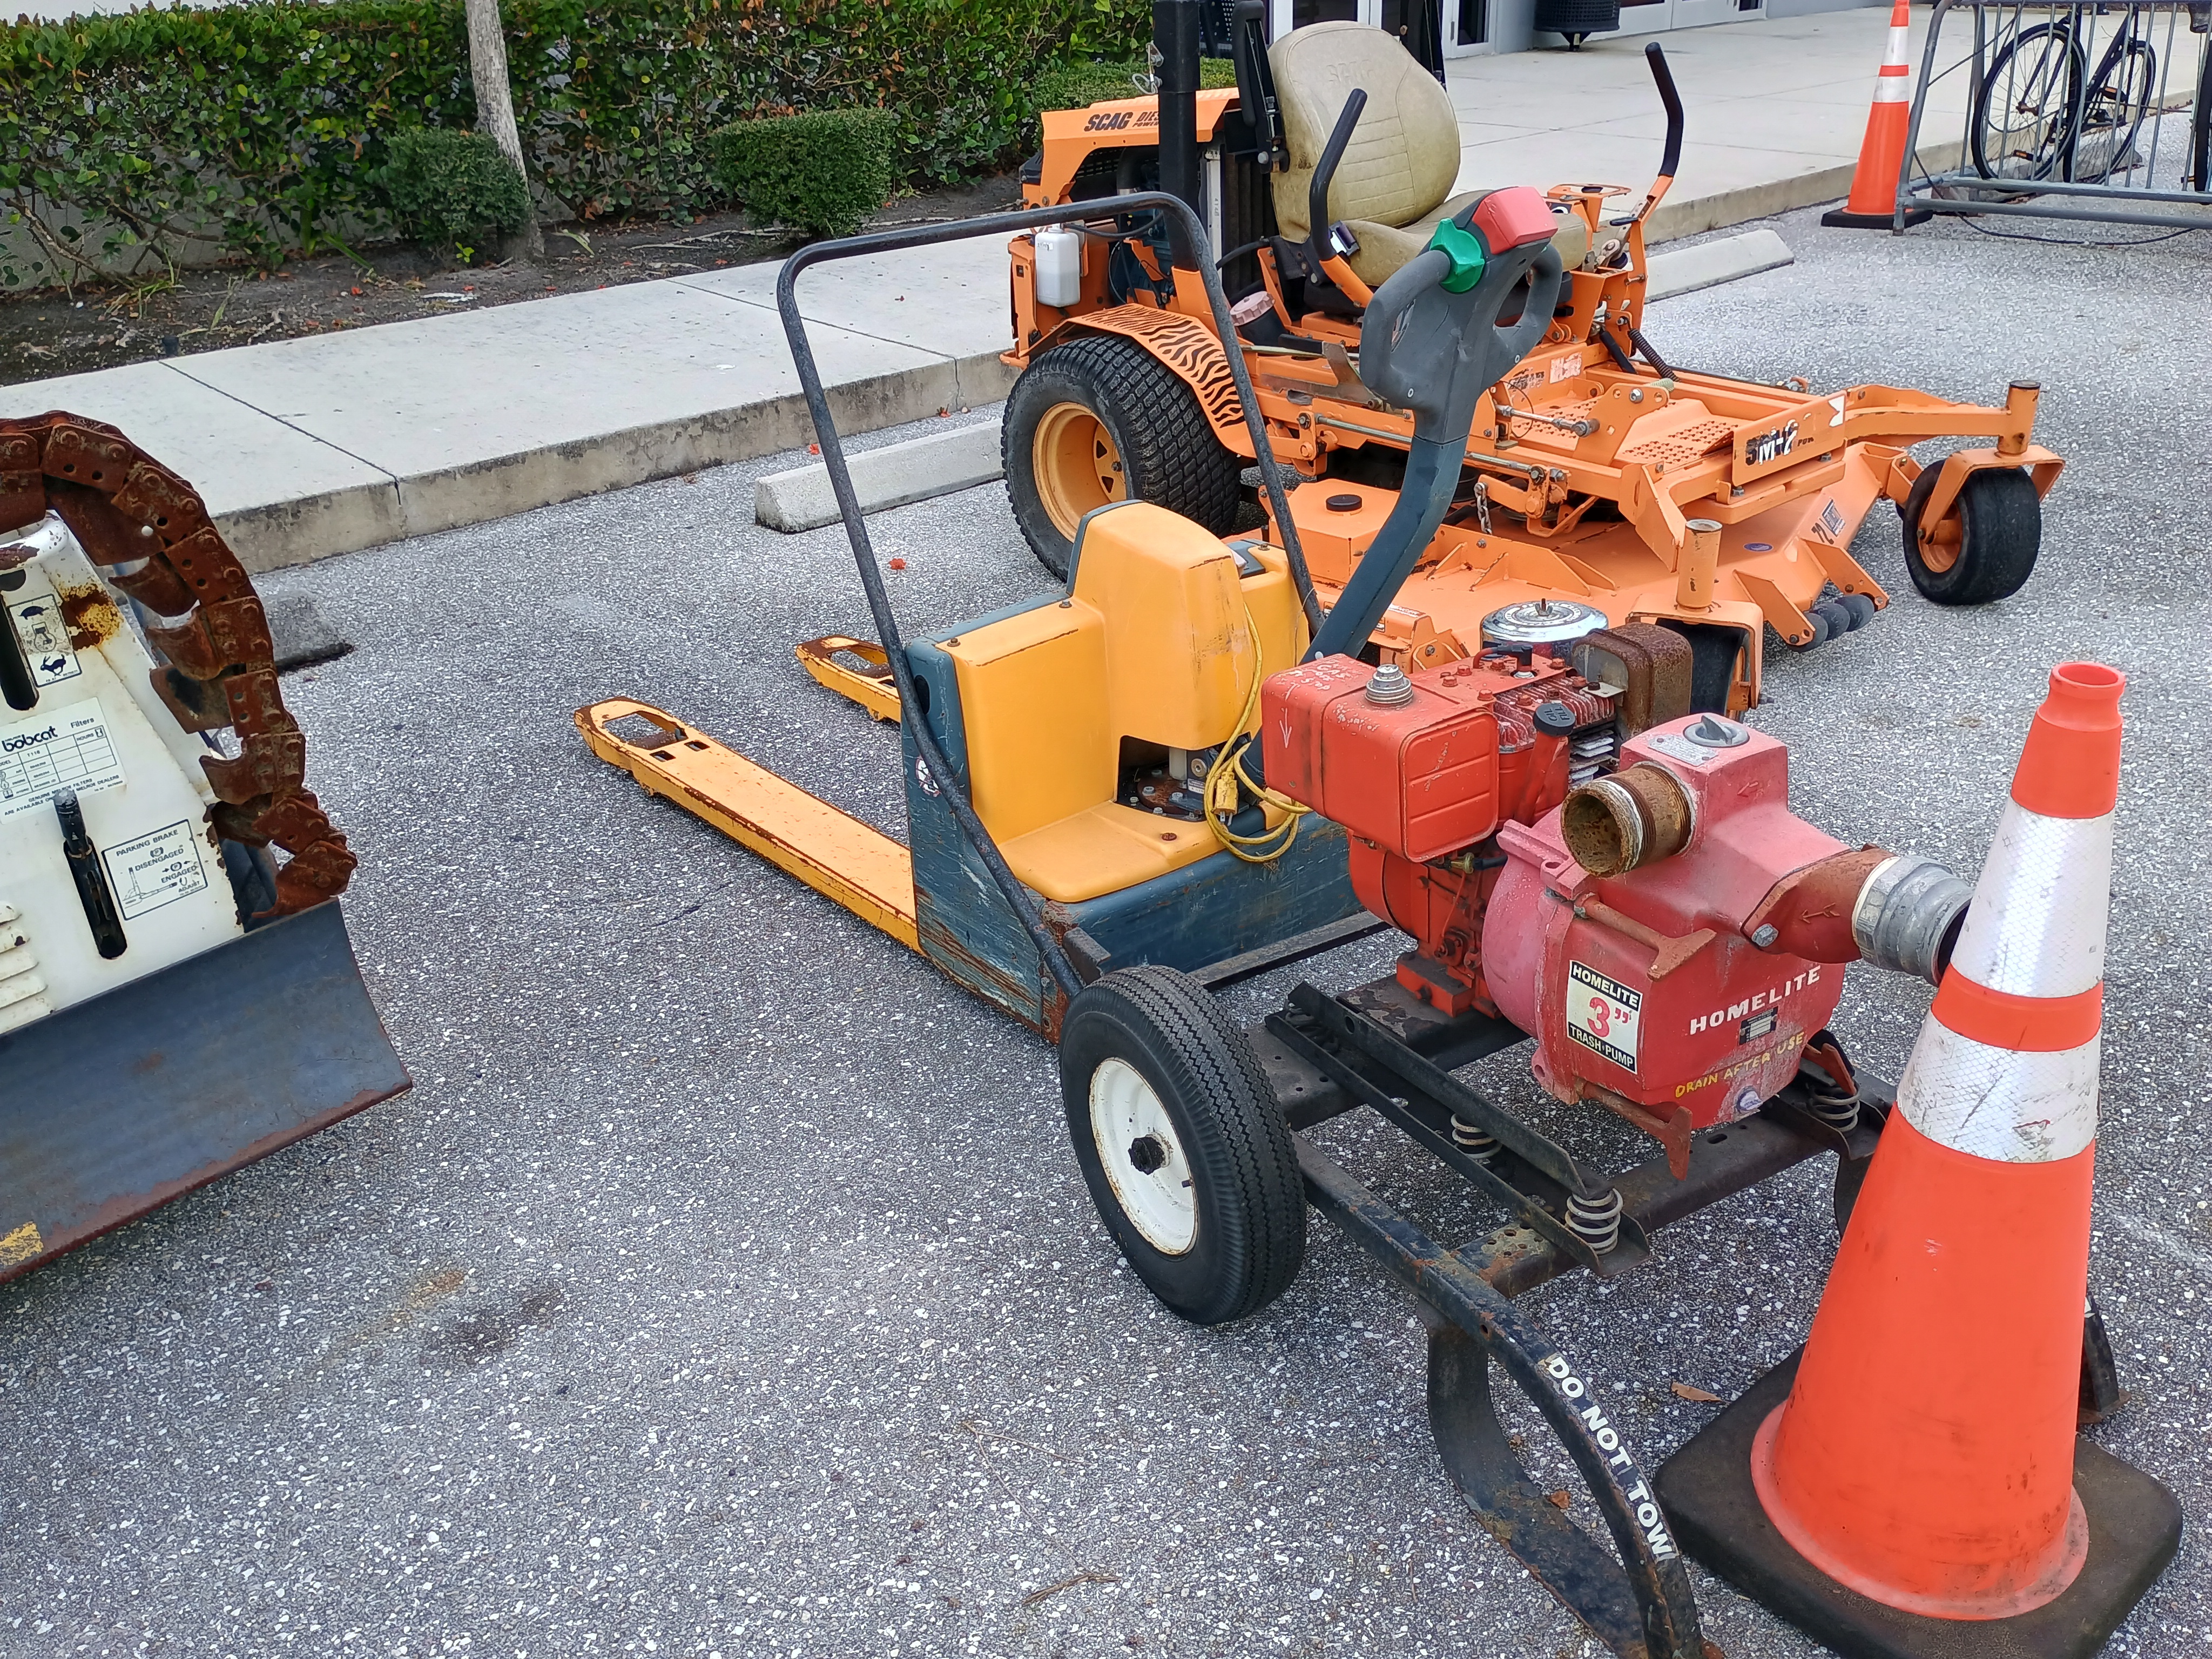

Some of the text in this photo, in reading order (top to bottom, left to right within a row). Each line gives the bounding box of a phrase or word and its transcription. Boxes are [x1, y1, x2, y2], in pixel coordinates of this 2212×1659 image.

[1084, 111, 1159, 132] SCAG DIE
[70, 718, 95, 729] Filters
[1544, 709, 1558, 721] OIL
[1555, 707, 1570, 720] FILL
[2, 726, 58, 752] bobcat
[77, 733, 94, 741] HOURS
[16, 800, 44, 812] AVAILABLE
[76, 783, 96, 792] MELROE
[97, 774, 119, 785] DEALERS
[29, 792, 50, 802] GENUINE
[73, 778, 93, 787] FILTERS
[116, 830, 179, 857] PARKING BRAKE
[135, 848, 184, 871] DISENGAGED
[161, 865, 198, 884] ENGAGED
[178, 880, 200, 893] ADJUST
[1572, 964, 1639, 1008] HOMELITE
[1690, 965, 1821, 1035] HOMELITE
[1570, 1024, 1634, 1067] TRASH PUMP
[1675, 1031, 1805, 1098] DRAIN AFTER USE
[1548, 1356, 1673, 1555] DO NOT TOW
